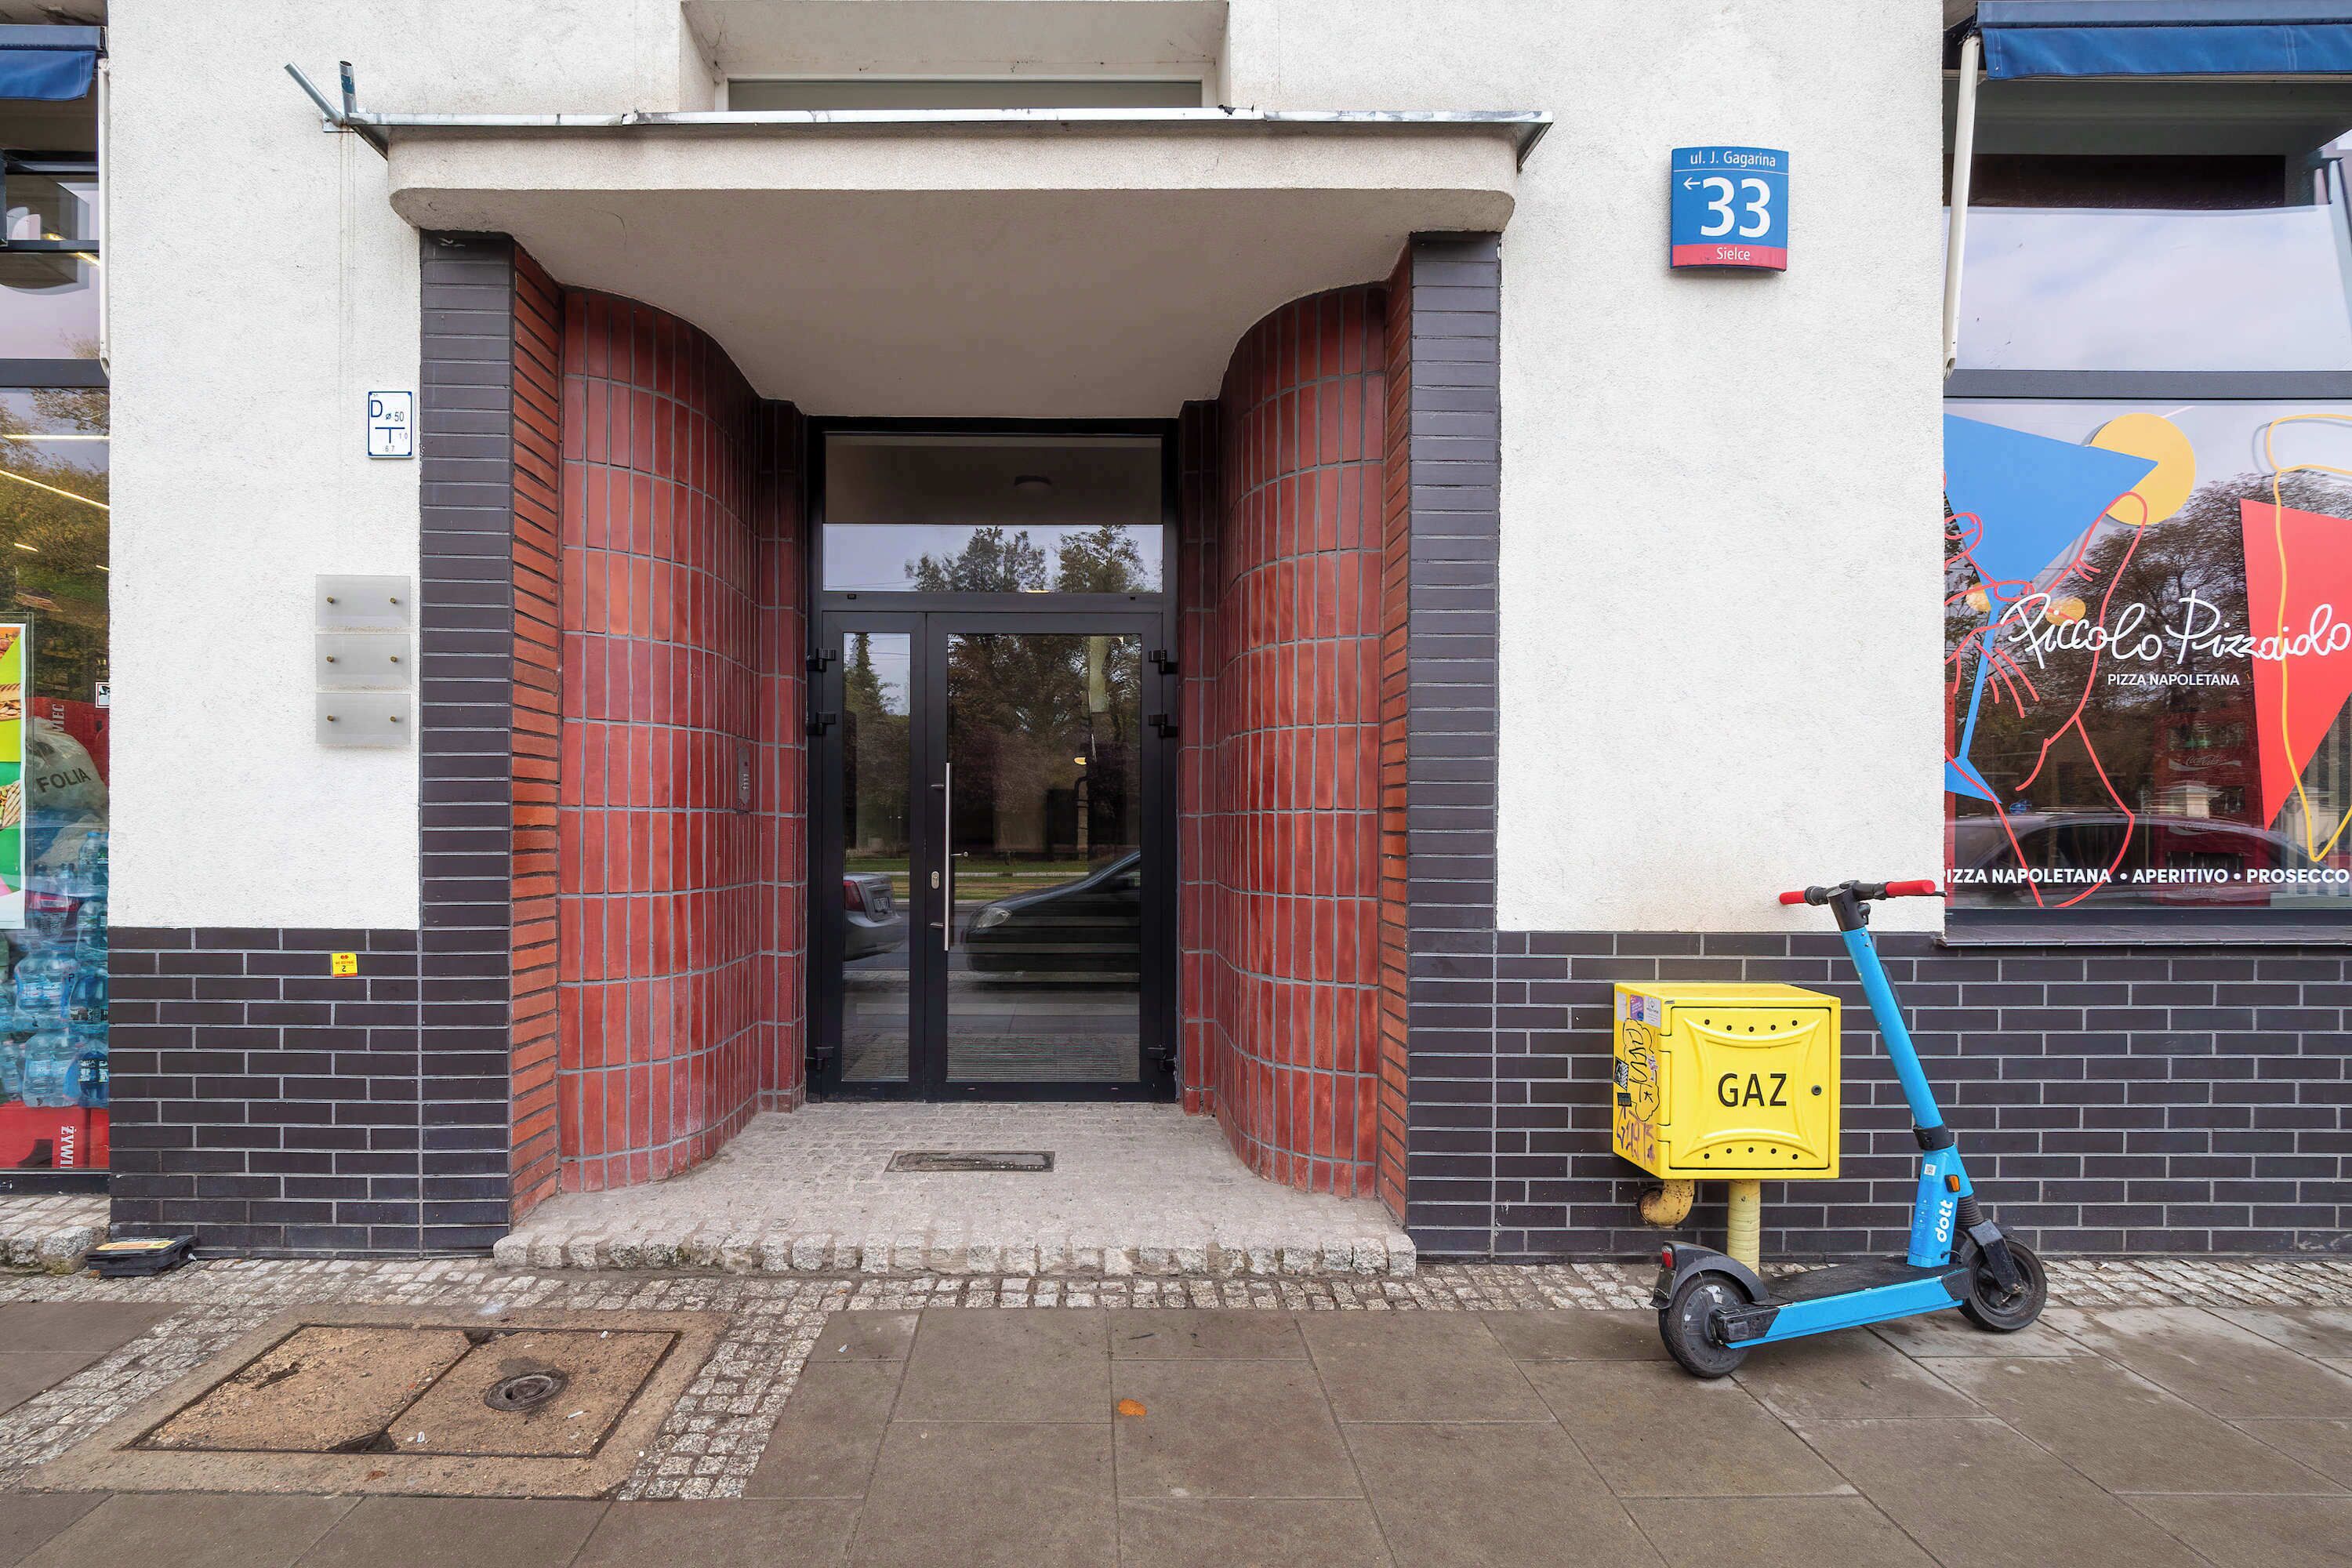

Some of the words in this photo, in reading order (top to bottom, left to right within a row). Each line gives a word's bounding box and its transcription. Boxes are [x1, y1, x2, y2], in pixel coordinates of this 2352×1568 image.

[1690, 151, 1706, 165] ul.
[1710, 151, 1719, 165] J.
[1723, 151, 1776, 168] Gagarina
[1700, 176, 1771, 238] 33
[1716, 247, 1751, 261] Sielce
[371, 400, 383, 417] D
[394, 412, 405, 422] 50
[1999, 591, 2163, 669] Piccolo
[2165, 589, 2352, 665] Pizzaiolo
[2107, 673, 2146, 686] PIZZA
[2149, 673, 2240, 686] NAPOLETANA
[35, 767, 92, 794] FOLIA
[1944, 868, 1987, 884] IZZA
[1992, 868, 2111, 884] NAPOLETANA
[2132, 868, 2228, 884] APERITIVO
[2246, 868, 2350, 884] PROSECCO
[1718, 1073, 1788, 1107] GAZ
[60, 1126, 77, 1168] ŻYWI
[1934, 1199, 1954, 1243] dott
